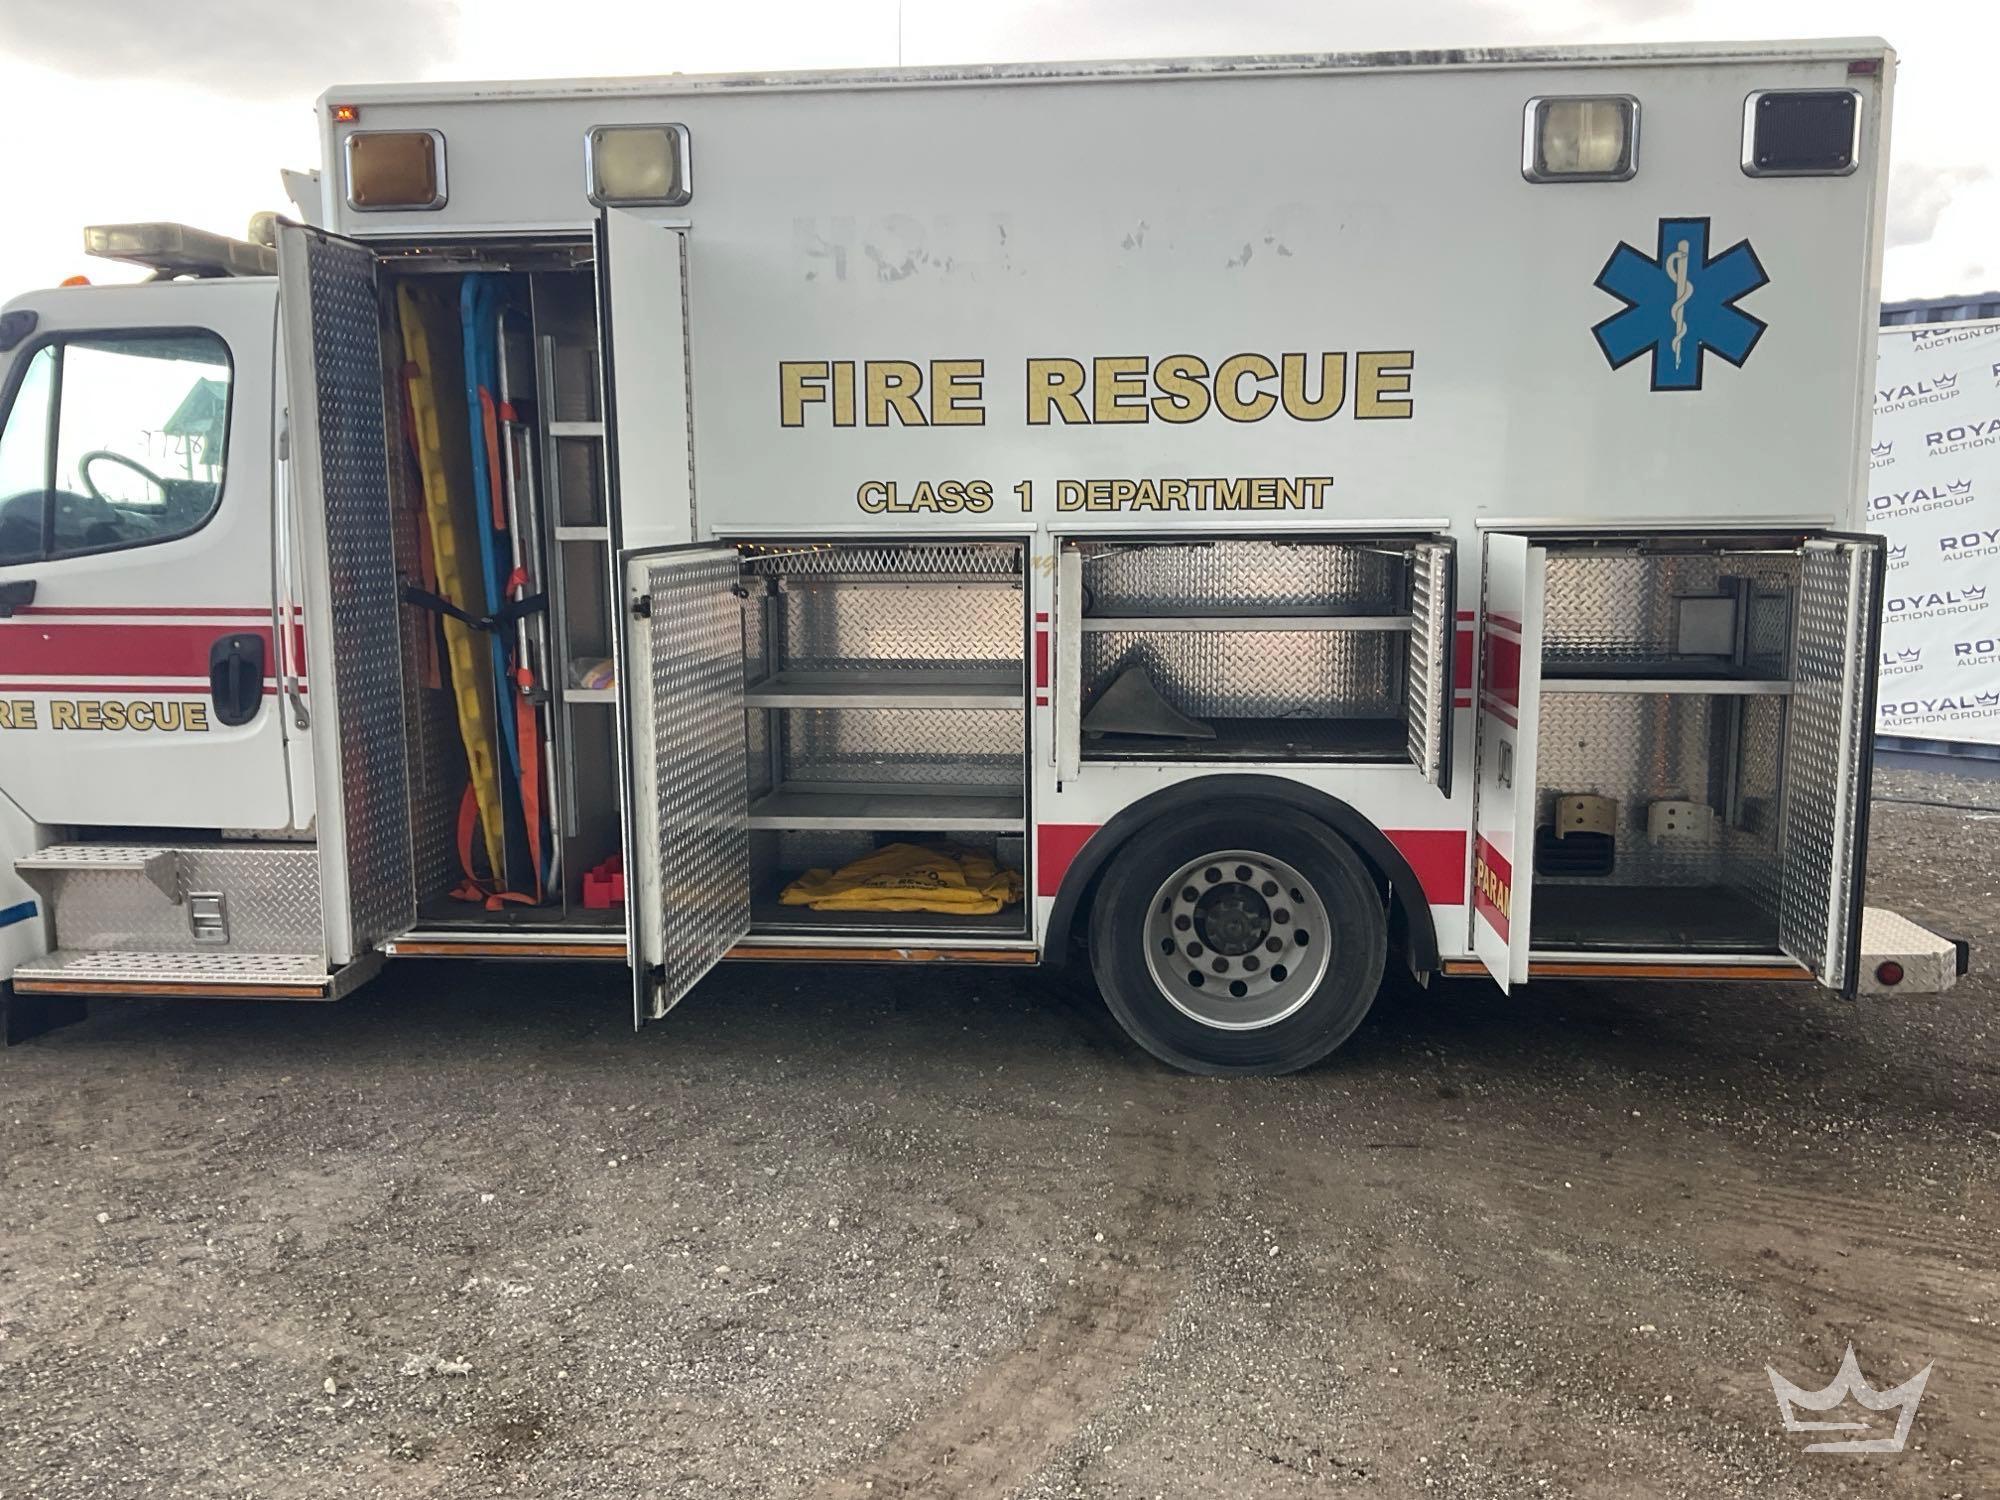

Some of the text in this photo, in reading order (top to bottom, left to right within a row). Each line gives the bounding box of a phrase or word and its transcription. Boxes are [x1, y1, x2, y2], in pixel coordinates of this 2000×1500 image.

[1914, 330, 1981, 352] AUCTION
[779, 350, 1415, 428] FIRE RESCUE
[1874, 381, 1933, 404] YAL
[1908, 389, 1960, 408] GROUP
[1929, 436, 1996, 457] AUCTION
[857, 477, 1334, 514] CLASS 1 DEPARTMENT
[1922, 496, 1974, 512] GROUP
[1936, 602, 1989, 616] GROUP
[50, 700, 209, 731] RESCUE
[1881, 696, 1974, 716] ROYAL
[1884, 714, 1947, 727] AUCTION
